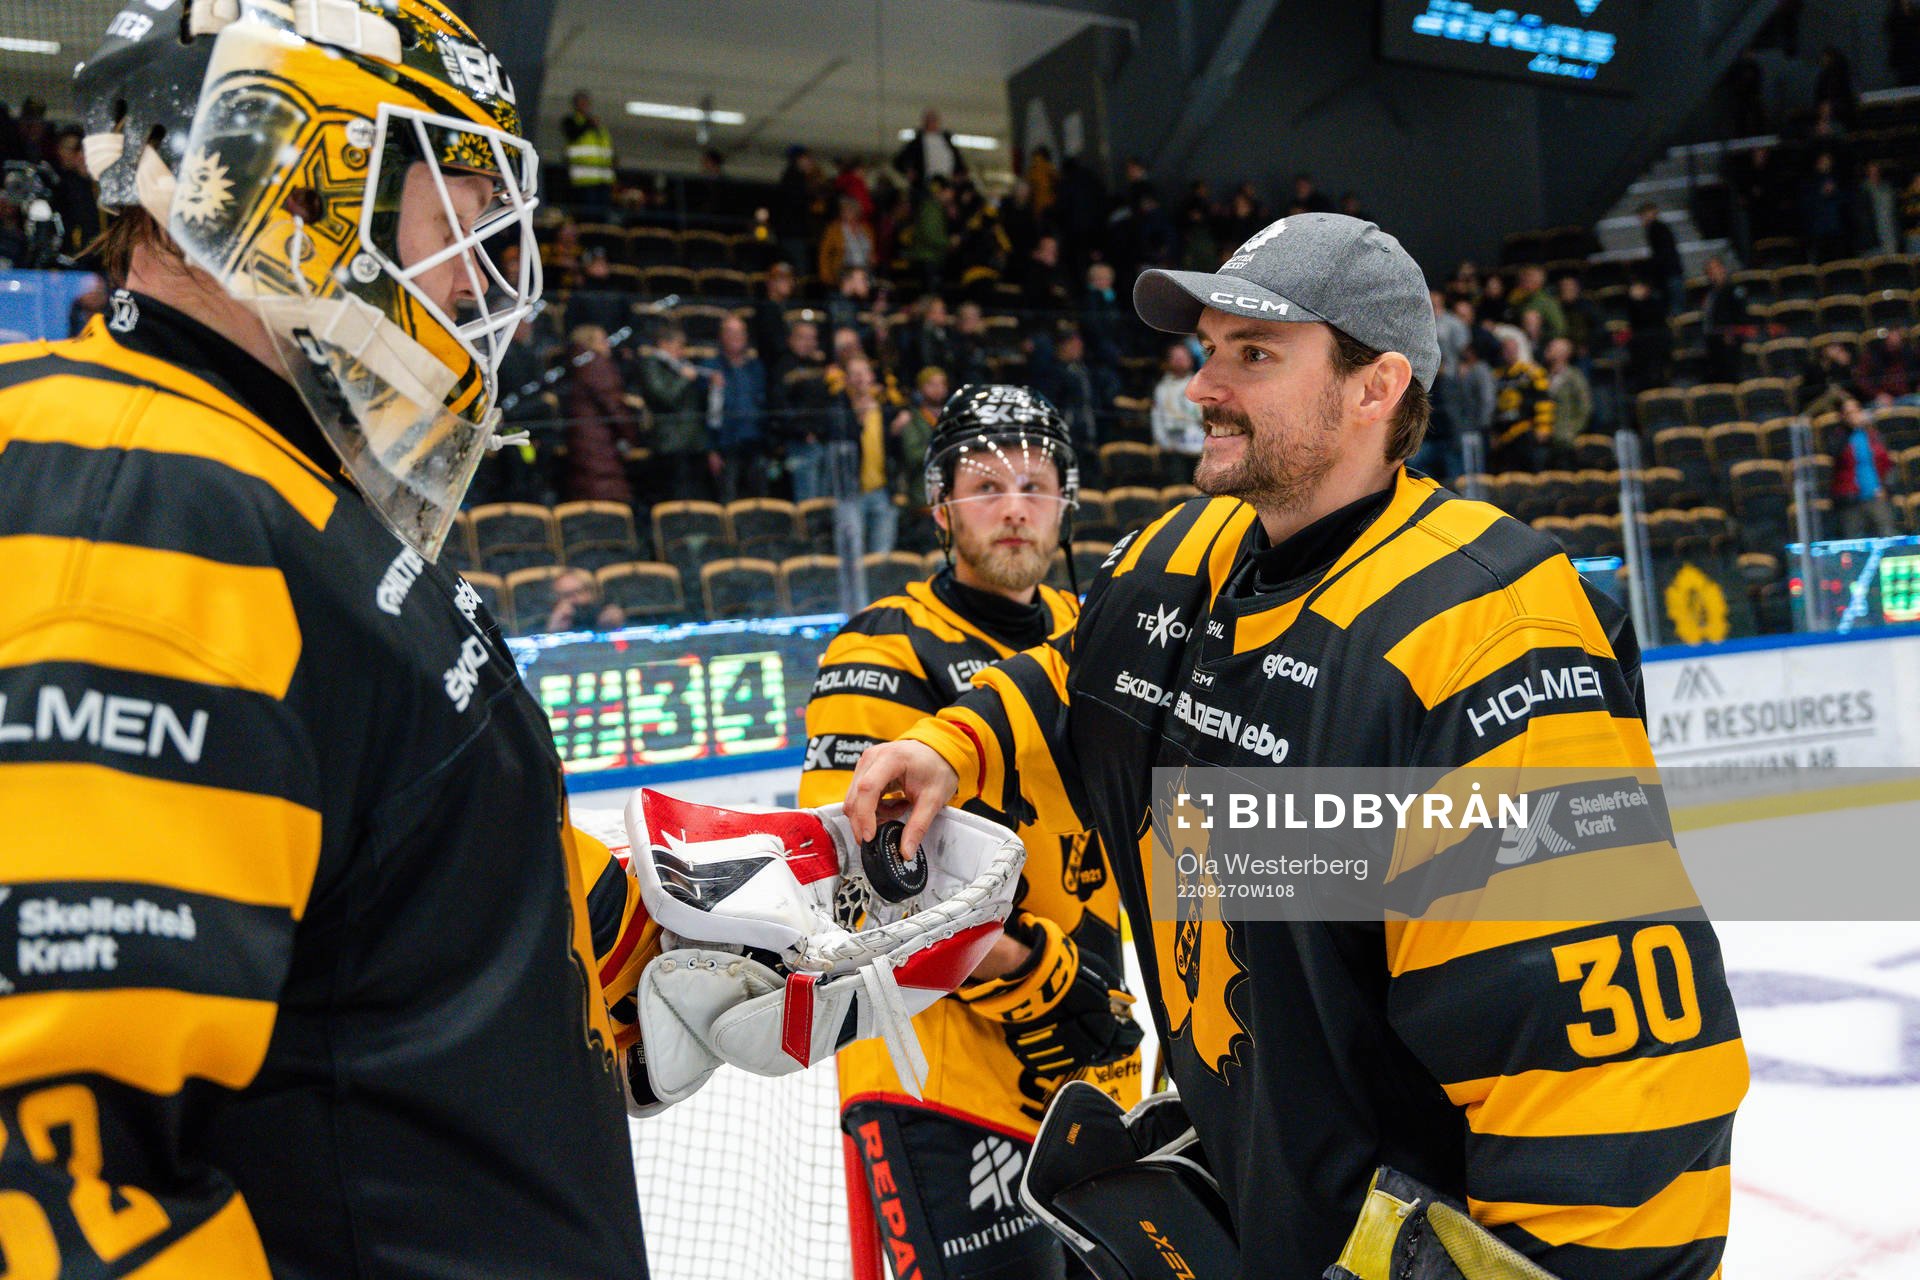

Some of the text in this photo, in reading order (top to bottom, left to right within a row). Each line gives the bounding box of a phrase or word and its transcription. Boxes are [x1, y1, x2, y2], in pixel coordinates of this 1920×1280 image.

[1210, 291, 1289, 316] CCM
[813, 669, 900, 695] HOLMEN
[1114, 670, 1174, 708] ŠKODA
[1704, 689, 1876, 740] RESOURCES
[1574, 815, 1616, 838] Kraft
[18, 897, 197, 941] Skellefteå
[17, 933, 119, 975] Kraft
[1551, 924, 1702, 1059] 30
[858, 1120, 924, 1280] REPA
